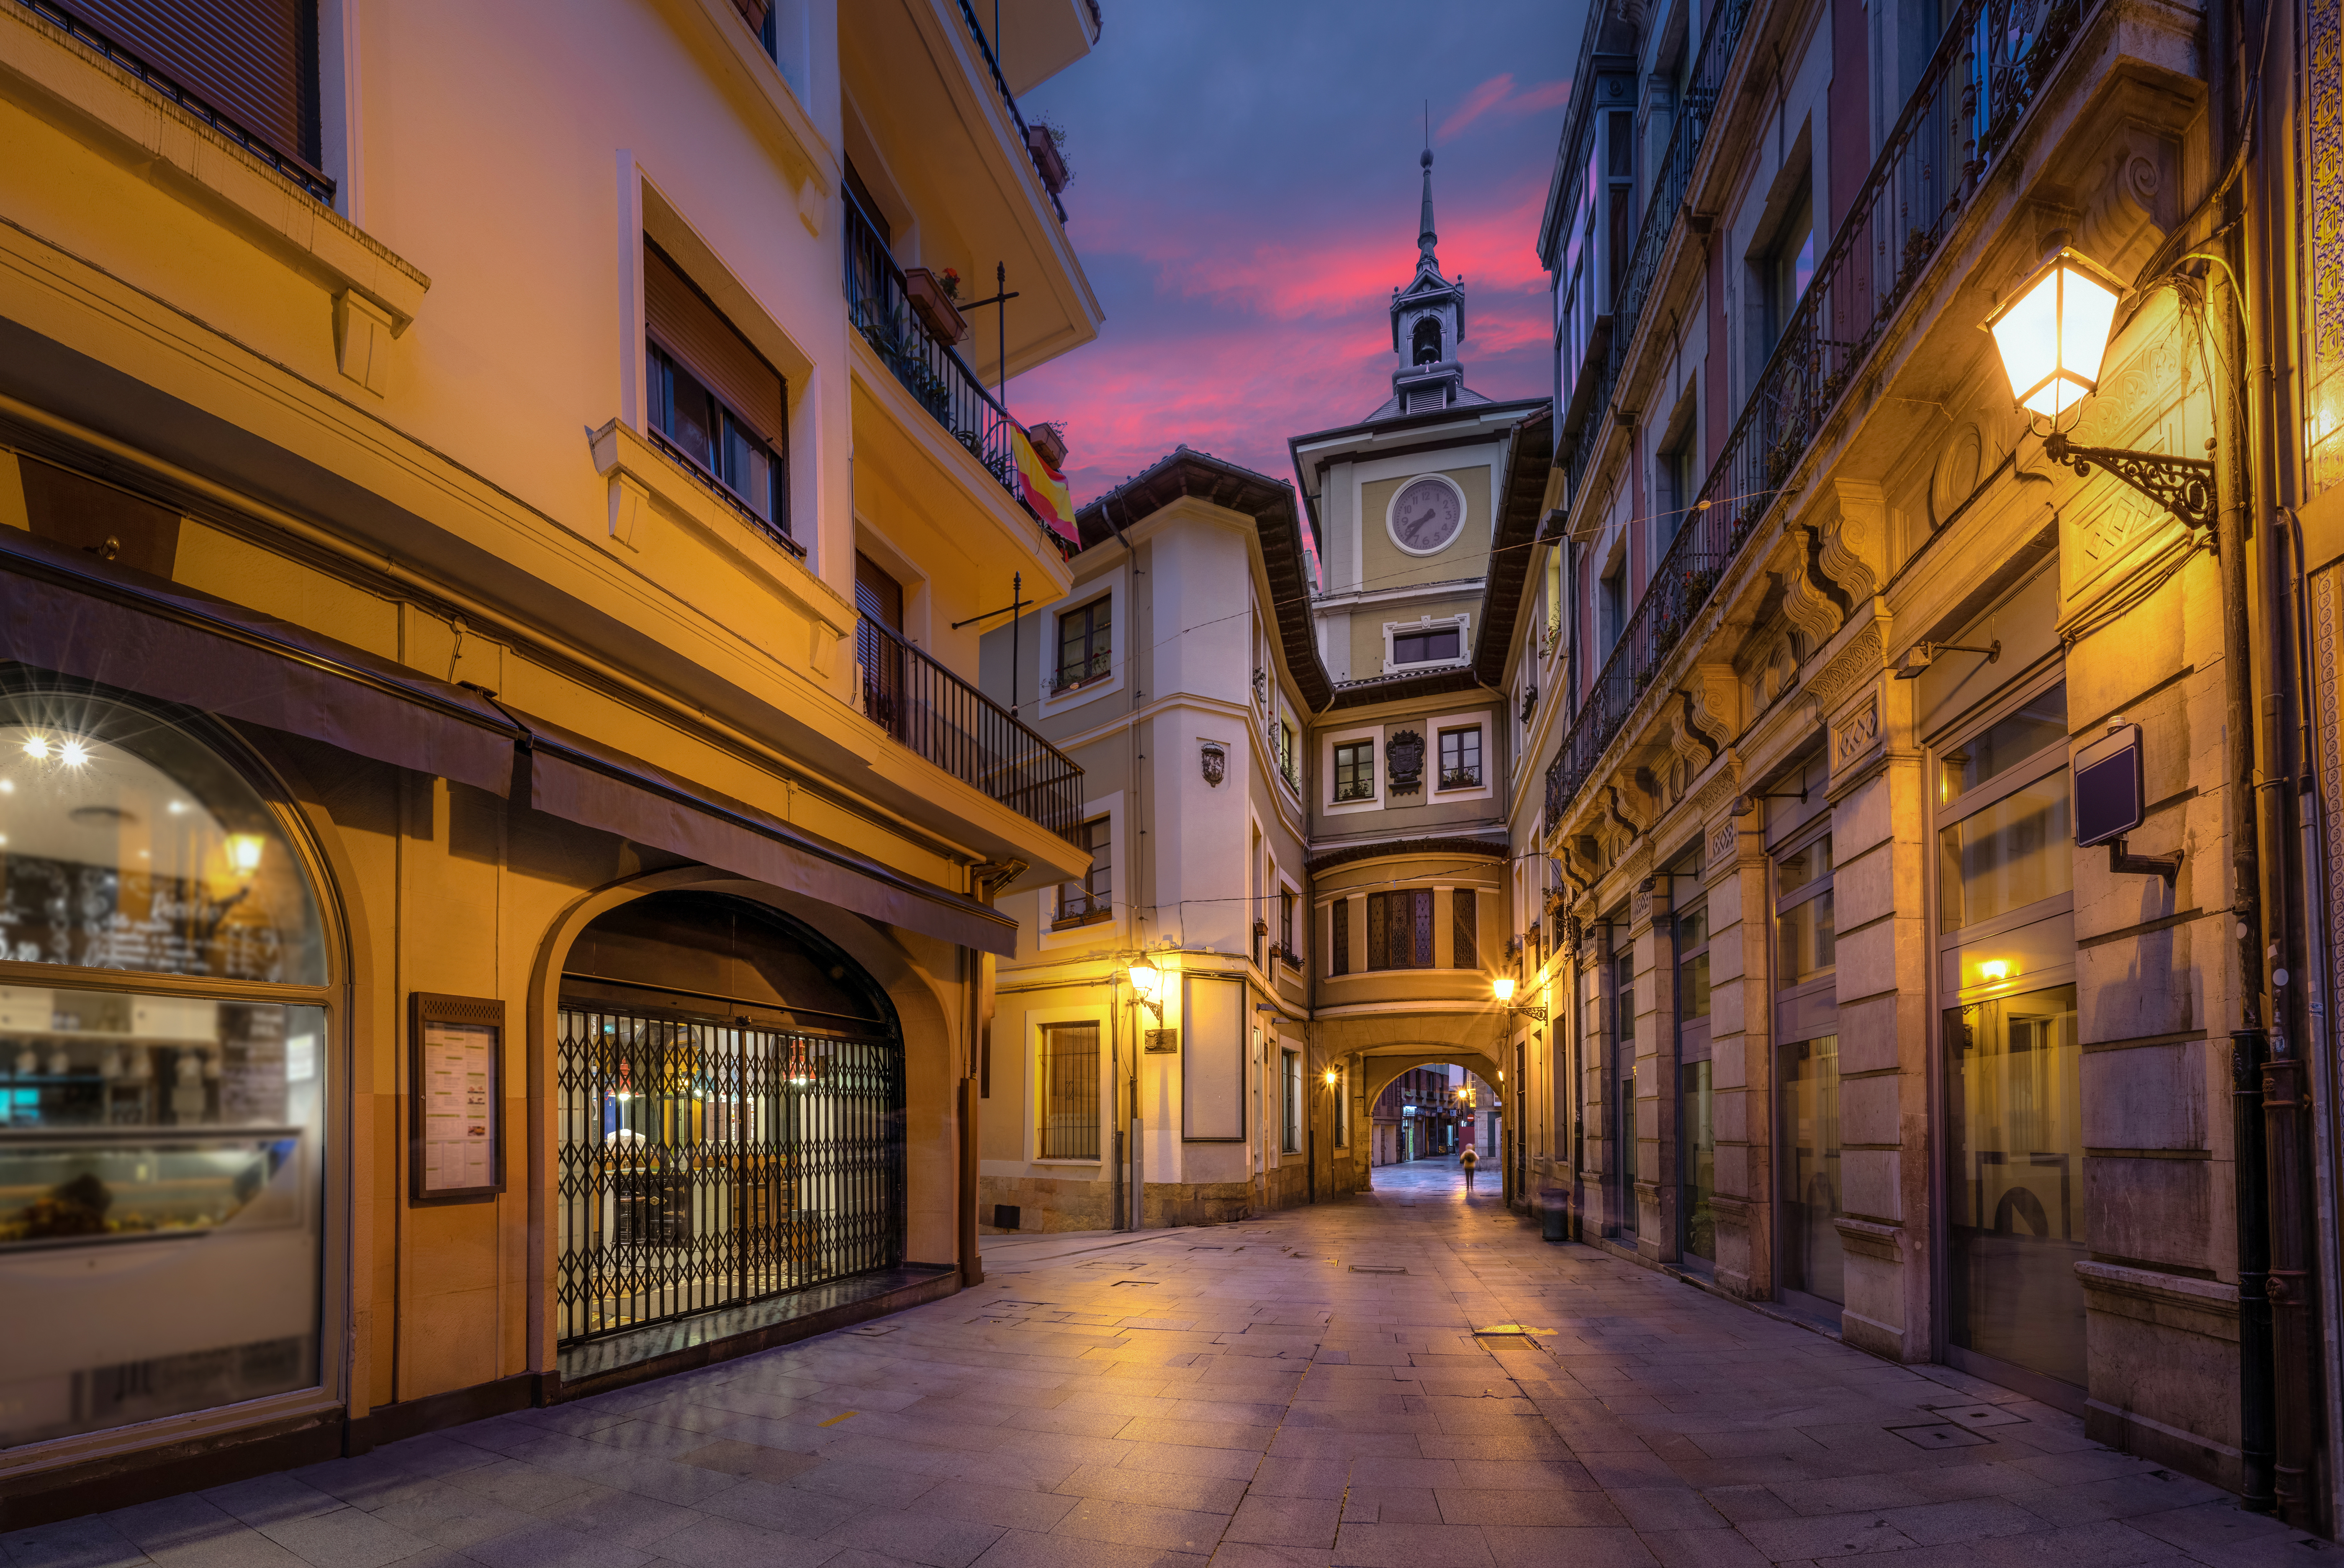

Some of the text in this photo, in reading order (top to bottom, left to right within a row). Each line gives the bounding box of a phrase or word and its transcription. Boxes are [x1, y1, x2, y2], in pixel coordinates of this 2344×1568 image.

[1421, 491, 1430, 500] 12
[1437, 493, 1439, 501] 1
[1412, 496, 1418, 505] 11
[1442, 500, 1449, 509] 2
[1404, 505, 1411, 514] 10
[1445, 511, 1452, 520] 3
[1401, 517, 1408, 526] 9
[1404, 527, 1411, 536] 8
[1414, 534, 1420, 544] 7
[1422, 536, 1430, 545] 6
[1434, 532, 1440, 541] 5
